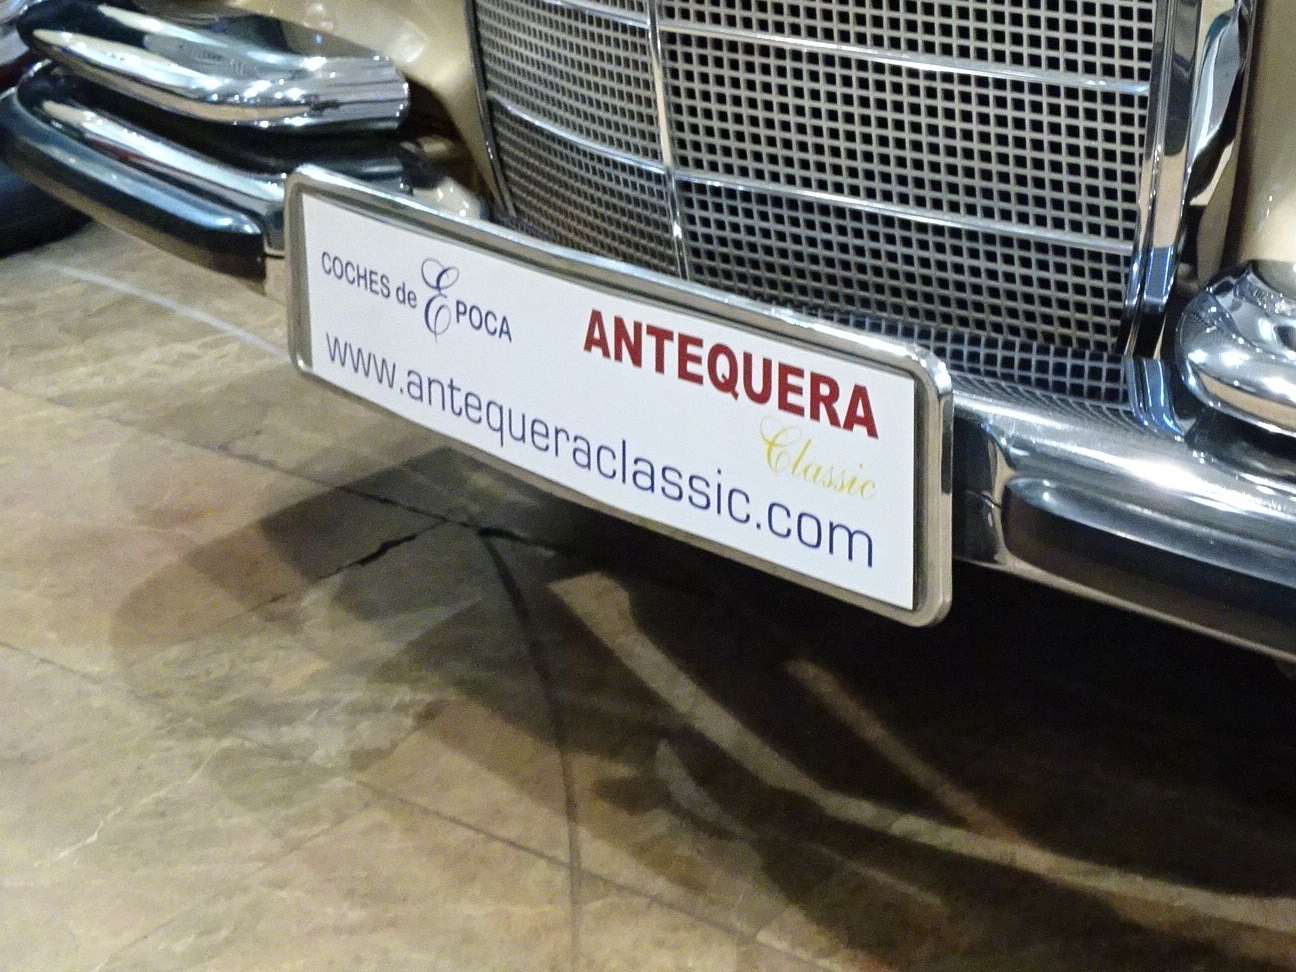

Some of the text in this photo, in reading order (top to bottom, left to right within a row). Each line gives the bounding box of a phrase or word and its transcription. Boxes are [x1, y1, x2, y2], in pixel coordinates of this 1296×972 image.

[321, 251, 391, 299] COCHES
[395, 281, 418, 309] de
[583, 308, 879, 440] ANTEQUERA
[326, 332, 874, 568] www.antequeraclassic.com
[759, 416, 877, 501] Classic
